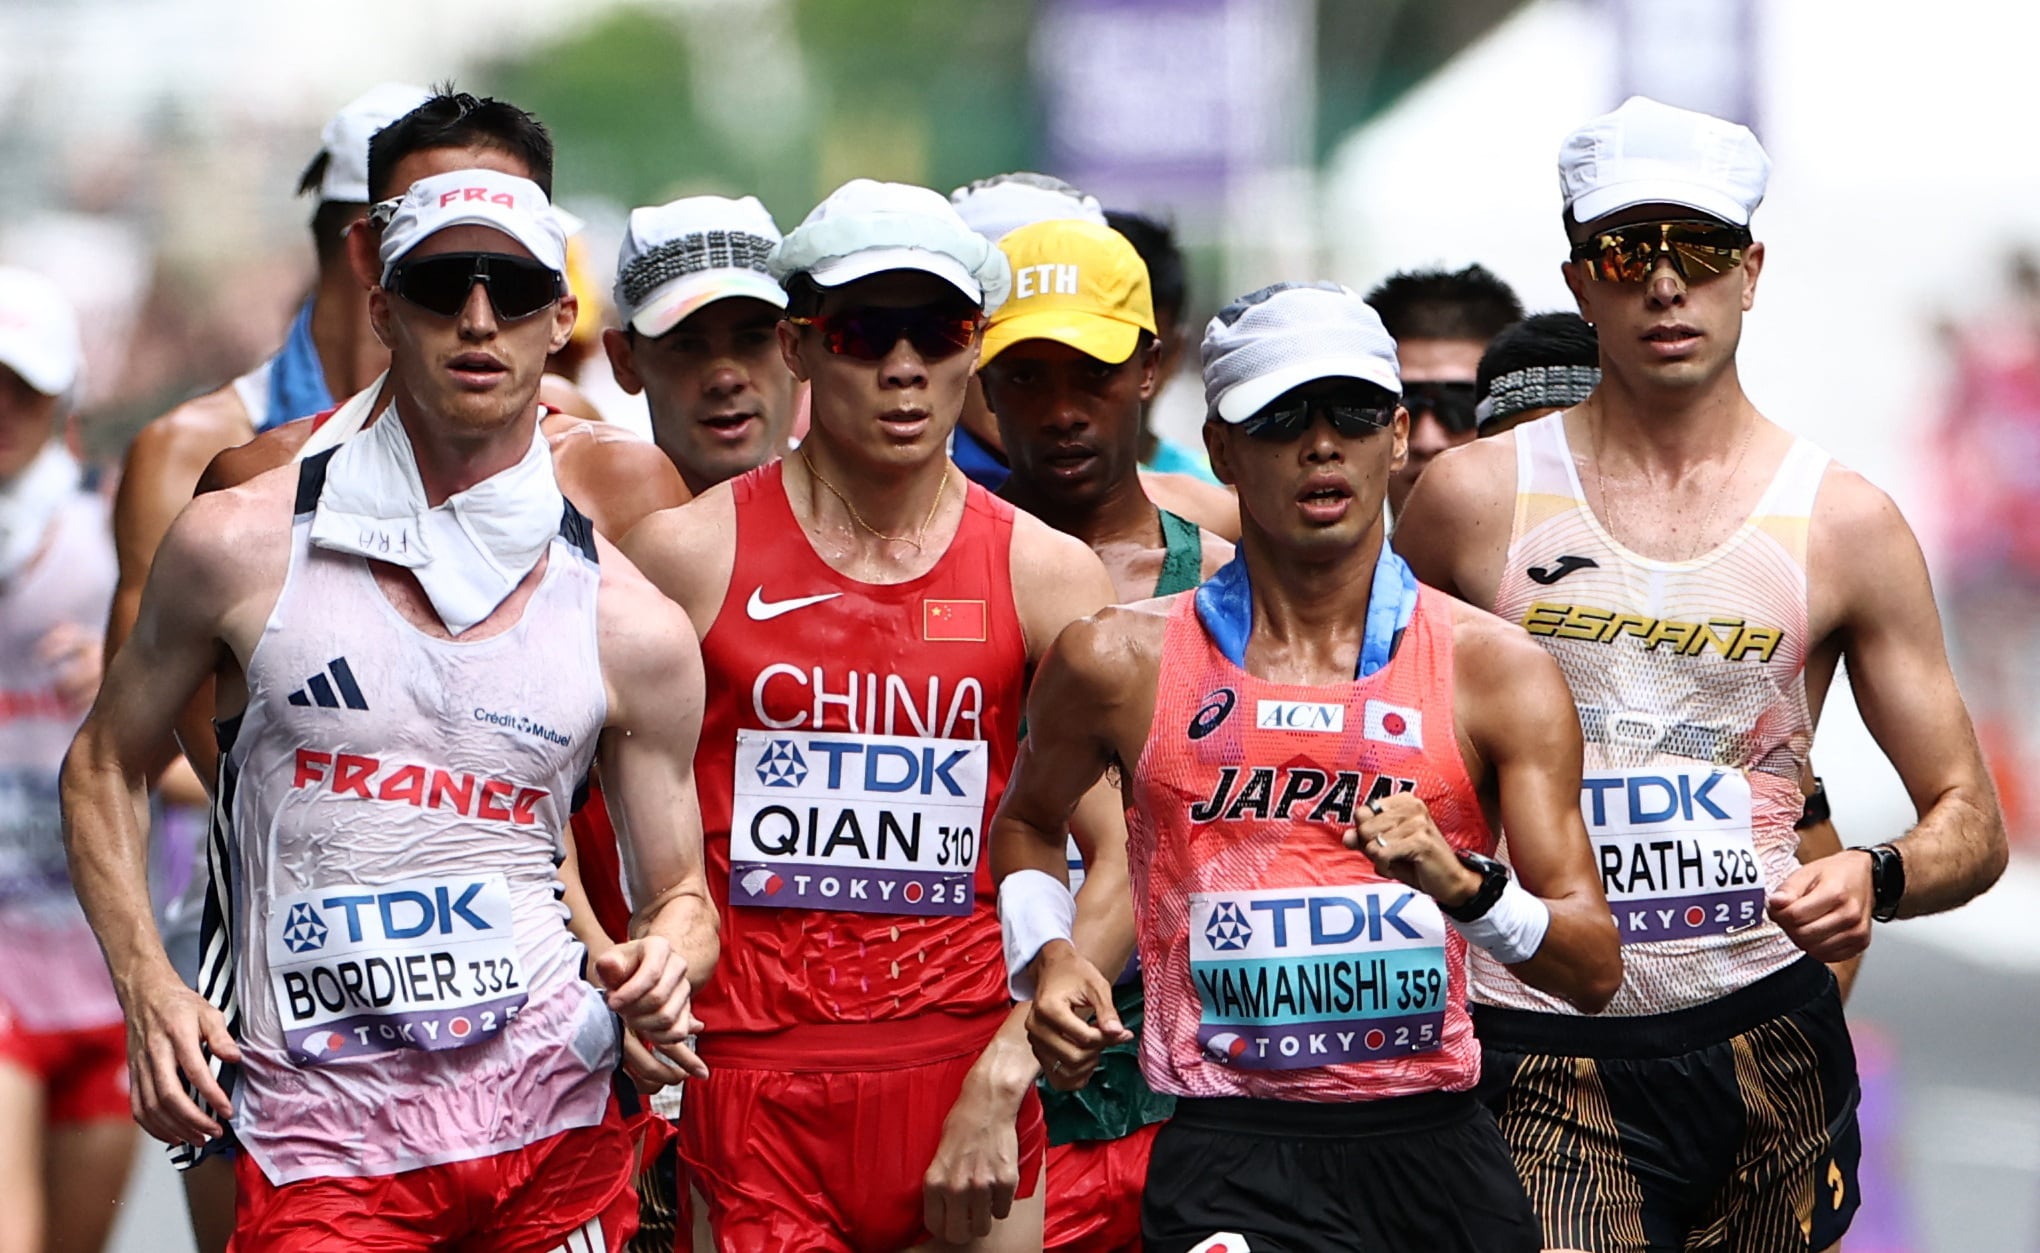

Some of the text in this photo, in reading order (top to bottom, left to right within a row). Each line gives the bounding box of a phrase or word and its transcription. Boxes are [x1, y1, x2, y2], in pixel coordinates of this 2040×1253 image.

[440, 187, 514, 209] FRA
[1016, 263, 1078, 299] ETH
[1520, 602, 1784, 663] ESPAÑA
[474, 707, 571, 747] Crédit Mutuel
[752, 662, 983, 741] CHINA
[1262, 703, 1341, 730] ACN
[808, 740, 971, 797] TDK
[1582, 773, 1733, 827] TDK
[750, 805, 975, 867] QIAN 310
[1713, 848, 1759, 888] 328
[323, 883, 494, 943] TDK
[1250, 893, 1425, 948] TDK
[283, 951, 520, 1021] BORDIER 332
[1198, 958, 1443, 1018] YAMANISHI 359
